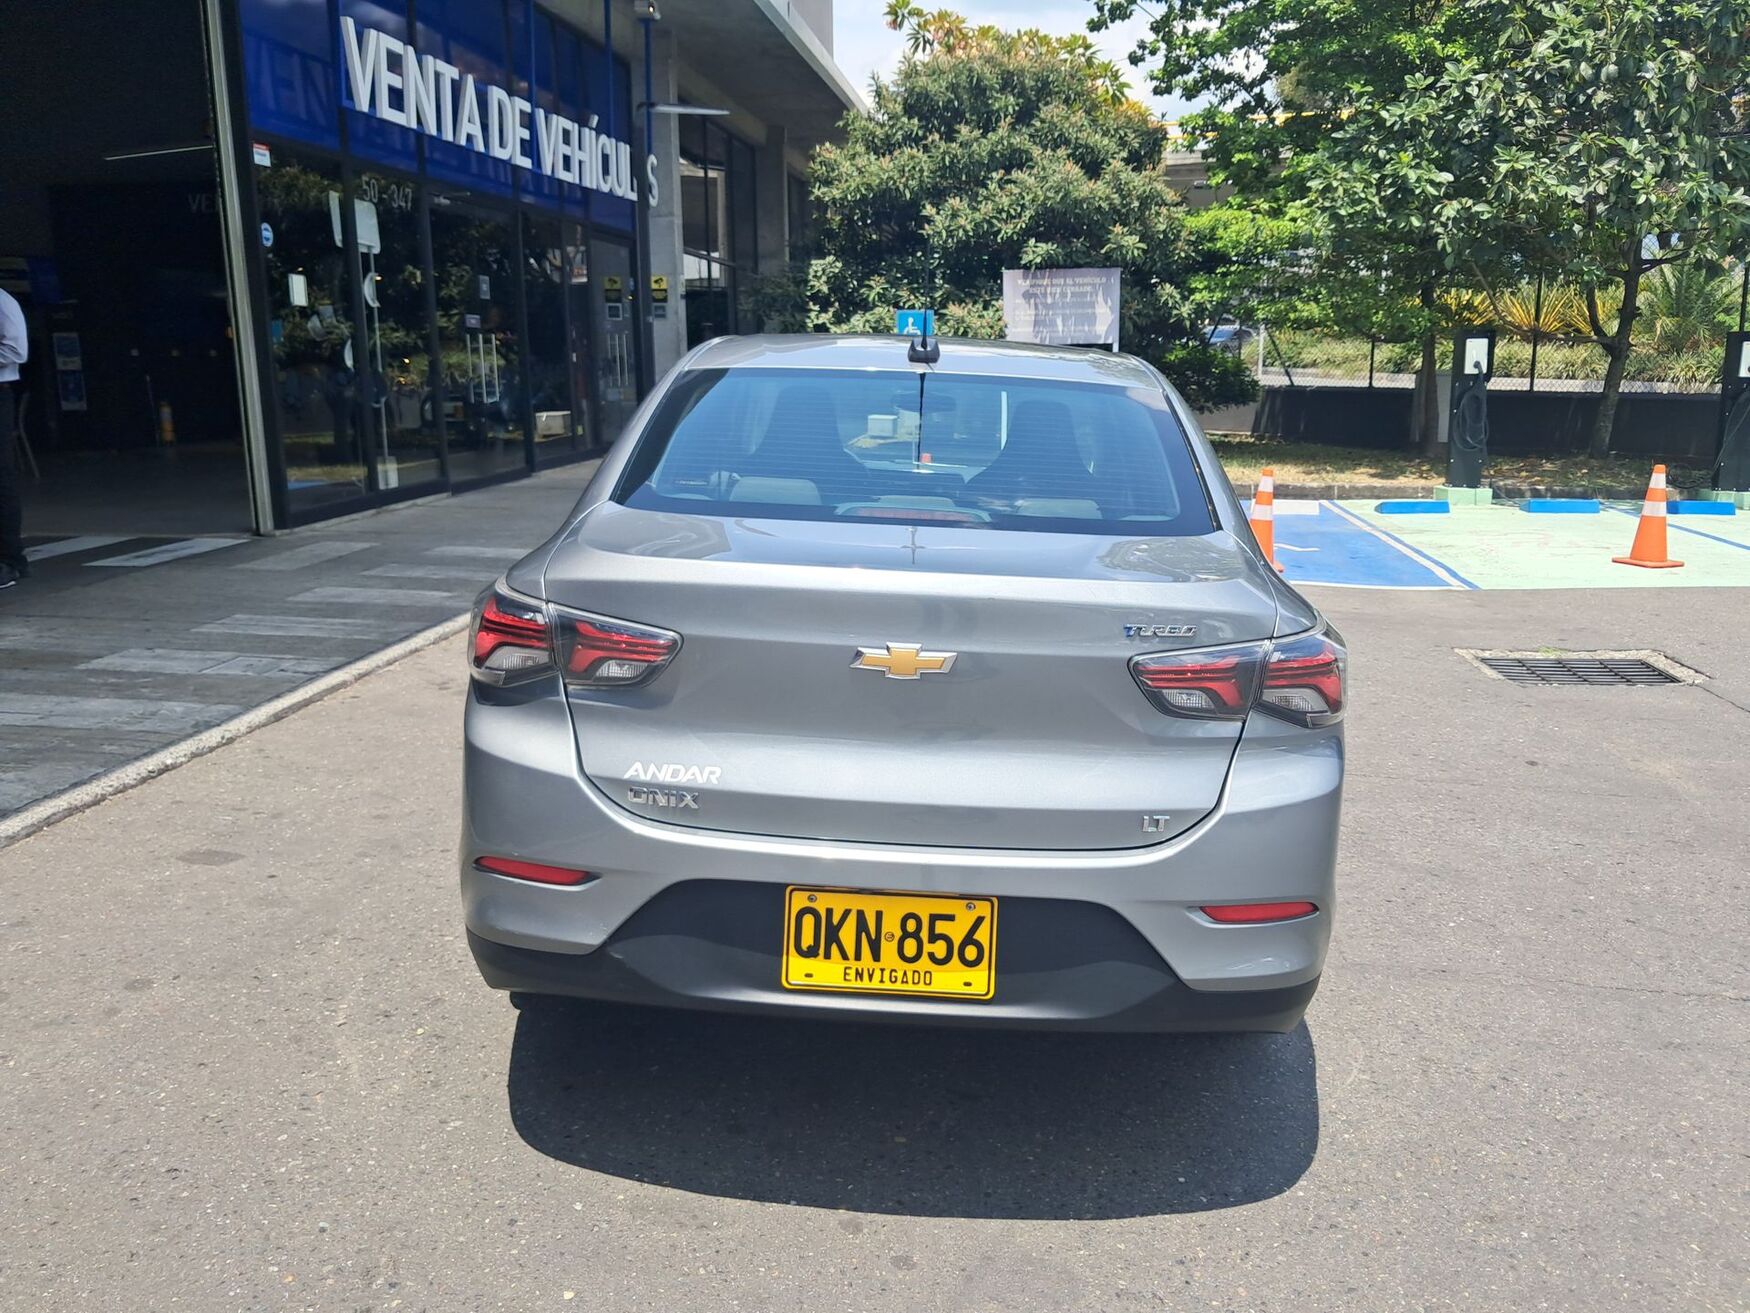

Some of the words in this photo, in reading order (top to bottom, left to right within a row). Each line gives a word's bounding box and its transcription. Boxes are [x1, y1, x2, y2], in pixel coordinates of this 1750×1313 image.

[340, 16, 486, 152] VENTA
[487, 85, 533, 169] DE
[534, 107, 659, 207] VEHÍCULS
[1124, 623, 1197, 638] TURBO
[623, 761, 722, 785] ANDAR
[627, 786, 700, 809] ONIX
[1142, 815, 1171, 832] LT
[793, 906, 883, 963] QKN
[897, 911, 986, 968] 856
[843, 966, 933, 986] ENVIGADO
